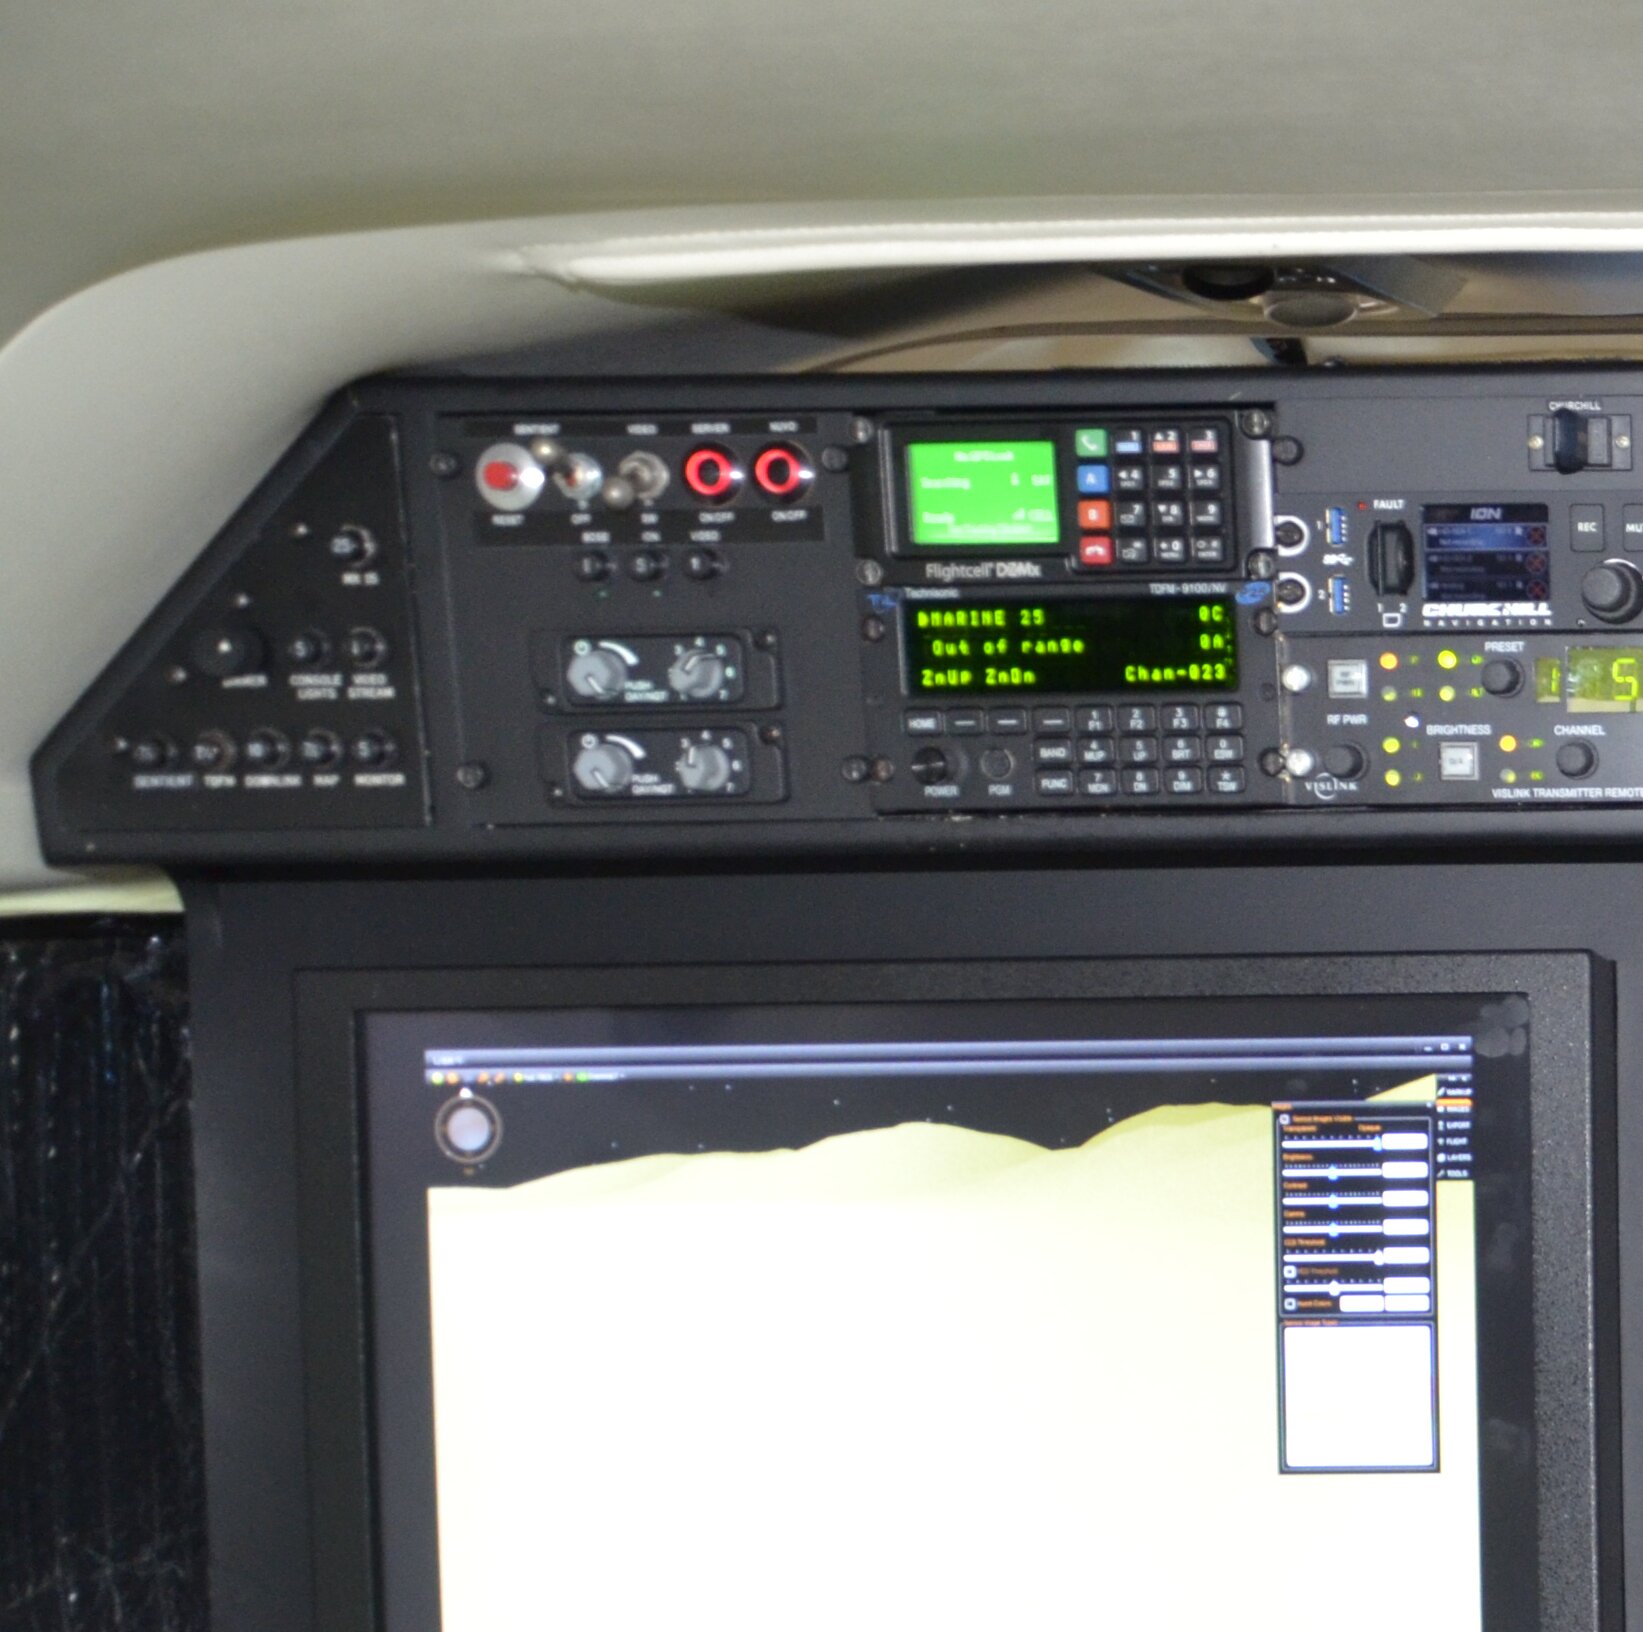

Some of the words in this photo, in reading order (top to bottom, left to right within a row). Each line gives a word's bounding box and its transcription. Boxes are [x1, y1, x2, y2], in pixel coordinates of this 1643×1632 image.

[1548, 401, 1601, 411] CHURCHILL
[626, 424, 657, 434] VIDEO
[691, 424, 731, 434] SERVER
[769, 422, 798, 432] NUVO
[1086, 474, 1095, 484] A
[1373, 500, 1405, 510] FAULT
[491, 515, 524, 525] RESET
[1470, 508, 1503, 520] ION
[1577, 523, 1596, 532] REC
[905, 587, 960, 599] Technisonic
[1422, 602, 1553, 617] CHURCHILL
[1423, 619, 1553, 627] NAVIGATION
[983, 639, 1008, 654] of
[1484, 641, 1525, 653] PRESET
[290, 674, 342, 686] CONSOLE
[298, 688, 337, 699] LIGHTS
[348, 687, 395, 698] STREAM
[1327, 715, 1340, 725] RF
[1341, 714, 1367, 725] PWR
[1426, 724, 1491, 736] BRIGHTNESS
[1554, 724, 1606, 736] CHANNEL
[313, 775, 340, 786] MAP
[354, 774, 406, 786] MONITOR
[924, 785, 959, 797] POWER
[1492, 788, 1531, 799] VISLINK
[1532, 788, 1602, 798] TRANSMITTER
